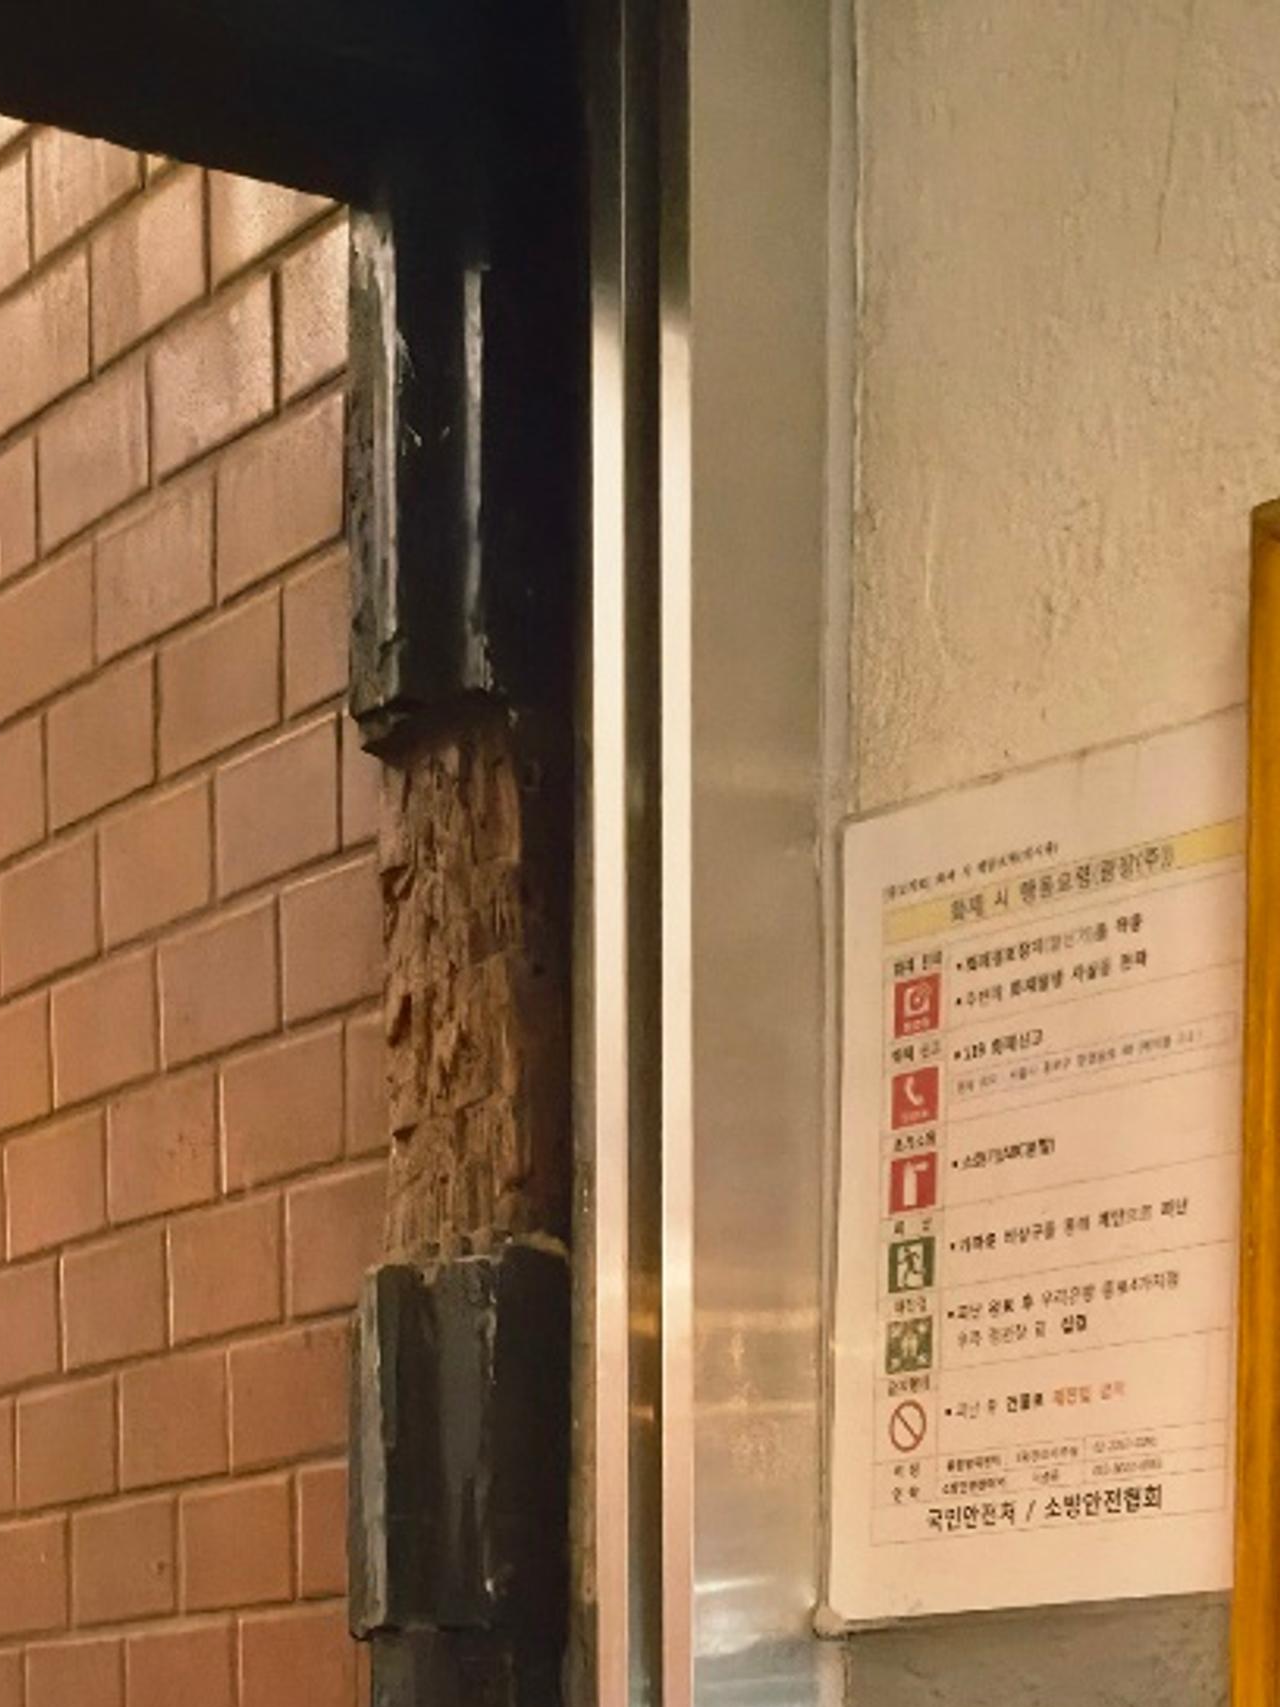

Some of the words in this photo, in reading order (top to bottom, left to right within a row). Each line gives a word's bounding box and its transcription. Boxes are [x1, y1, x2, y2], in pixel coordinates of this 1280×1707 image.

[950, 893, 984, 923] 화재
[994, 886, 1010, 909] 시
[926, 1499, 1017, 1534] 국민안전처
[1044, 1483, 1163, 1521] 소방안전협회
